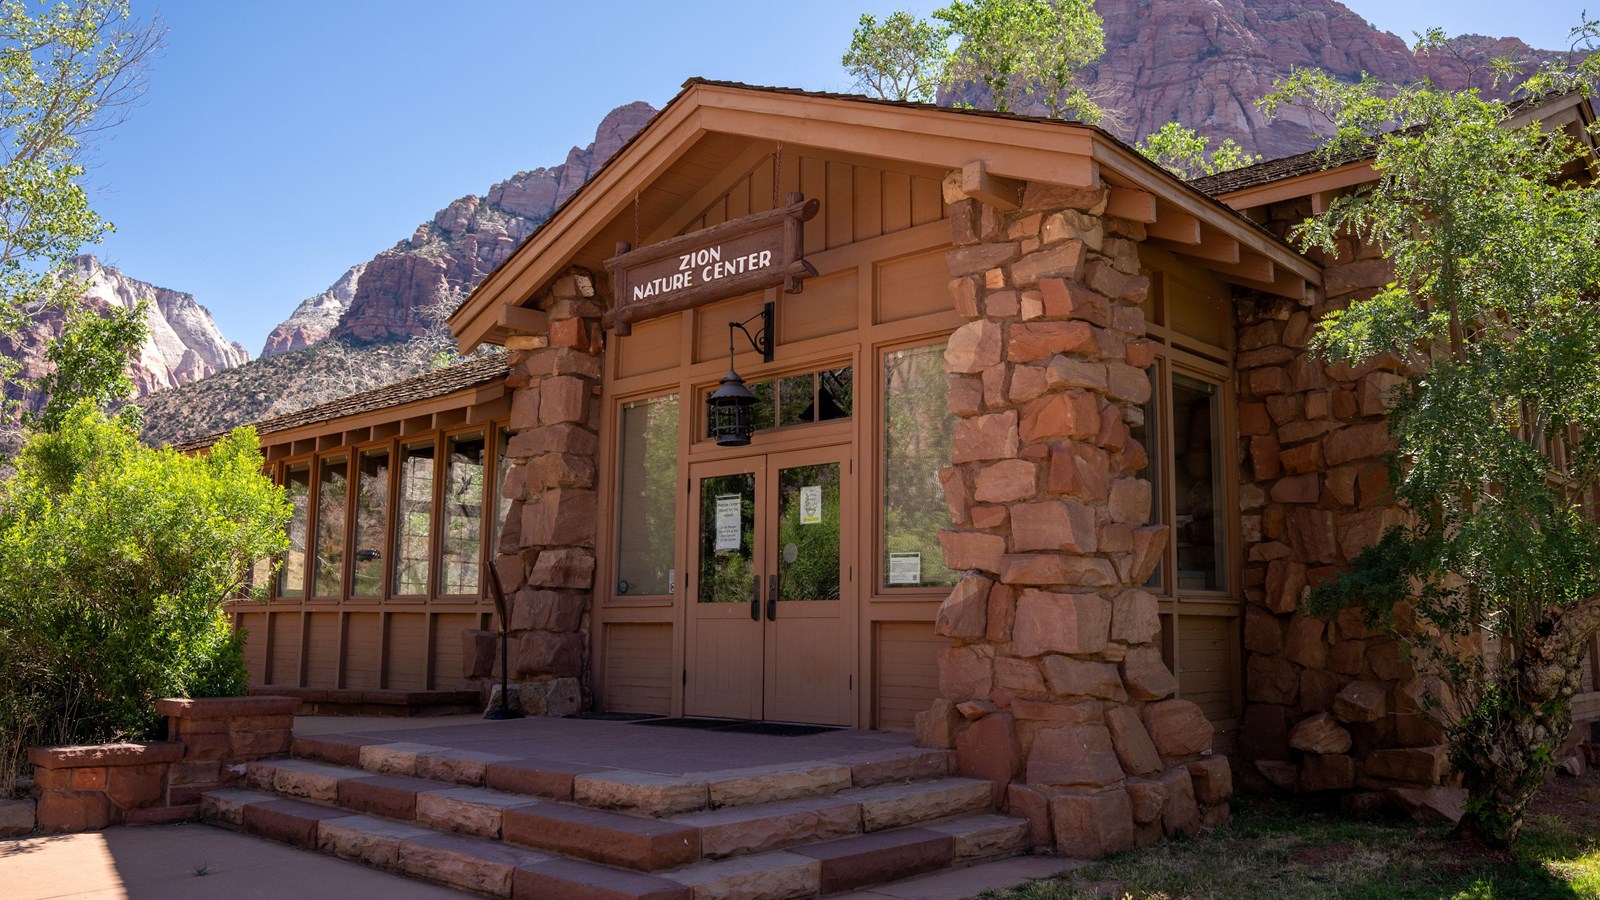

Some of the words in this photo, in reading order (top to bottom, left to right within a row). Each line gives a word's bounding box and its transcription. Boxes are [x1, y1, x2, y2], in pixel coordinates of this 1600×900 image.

[633, 271, 693, 301] NATURE
[702, 250, 772, 282] CENTER
[679, 245, 721, 271] ZION
